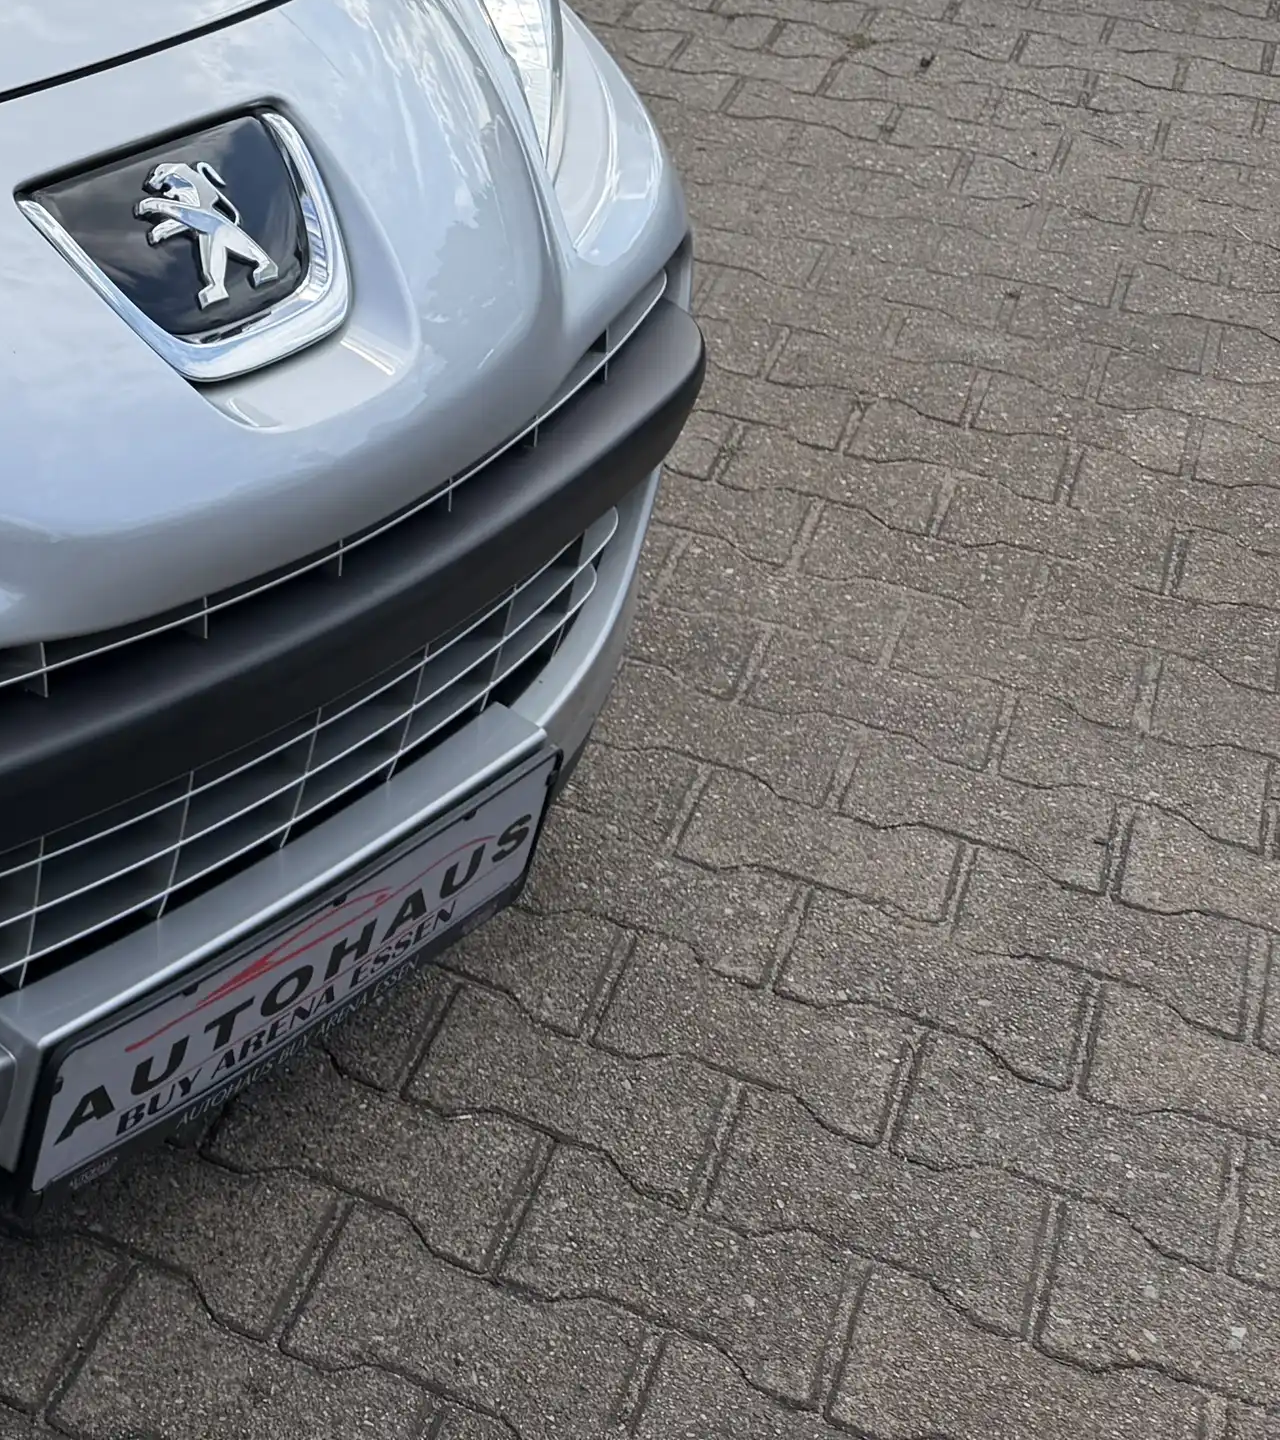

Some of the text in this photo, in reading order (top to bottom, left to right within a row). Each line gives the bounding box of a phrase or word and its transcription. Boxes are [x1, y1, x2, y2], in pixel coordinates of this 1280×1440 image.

[52, 813, 533, 1146] AUTOHAUS
[115, 899, 457, 1137] BUY ARENA ESSEN
[175, 1061, 274, 1130] AUTOHAUS
